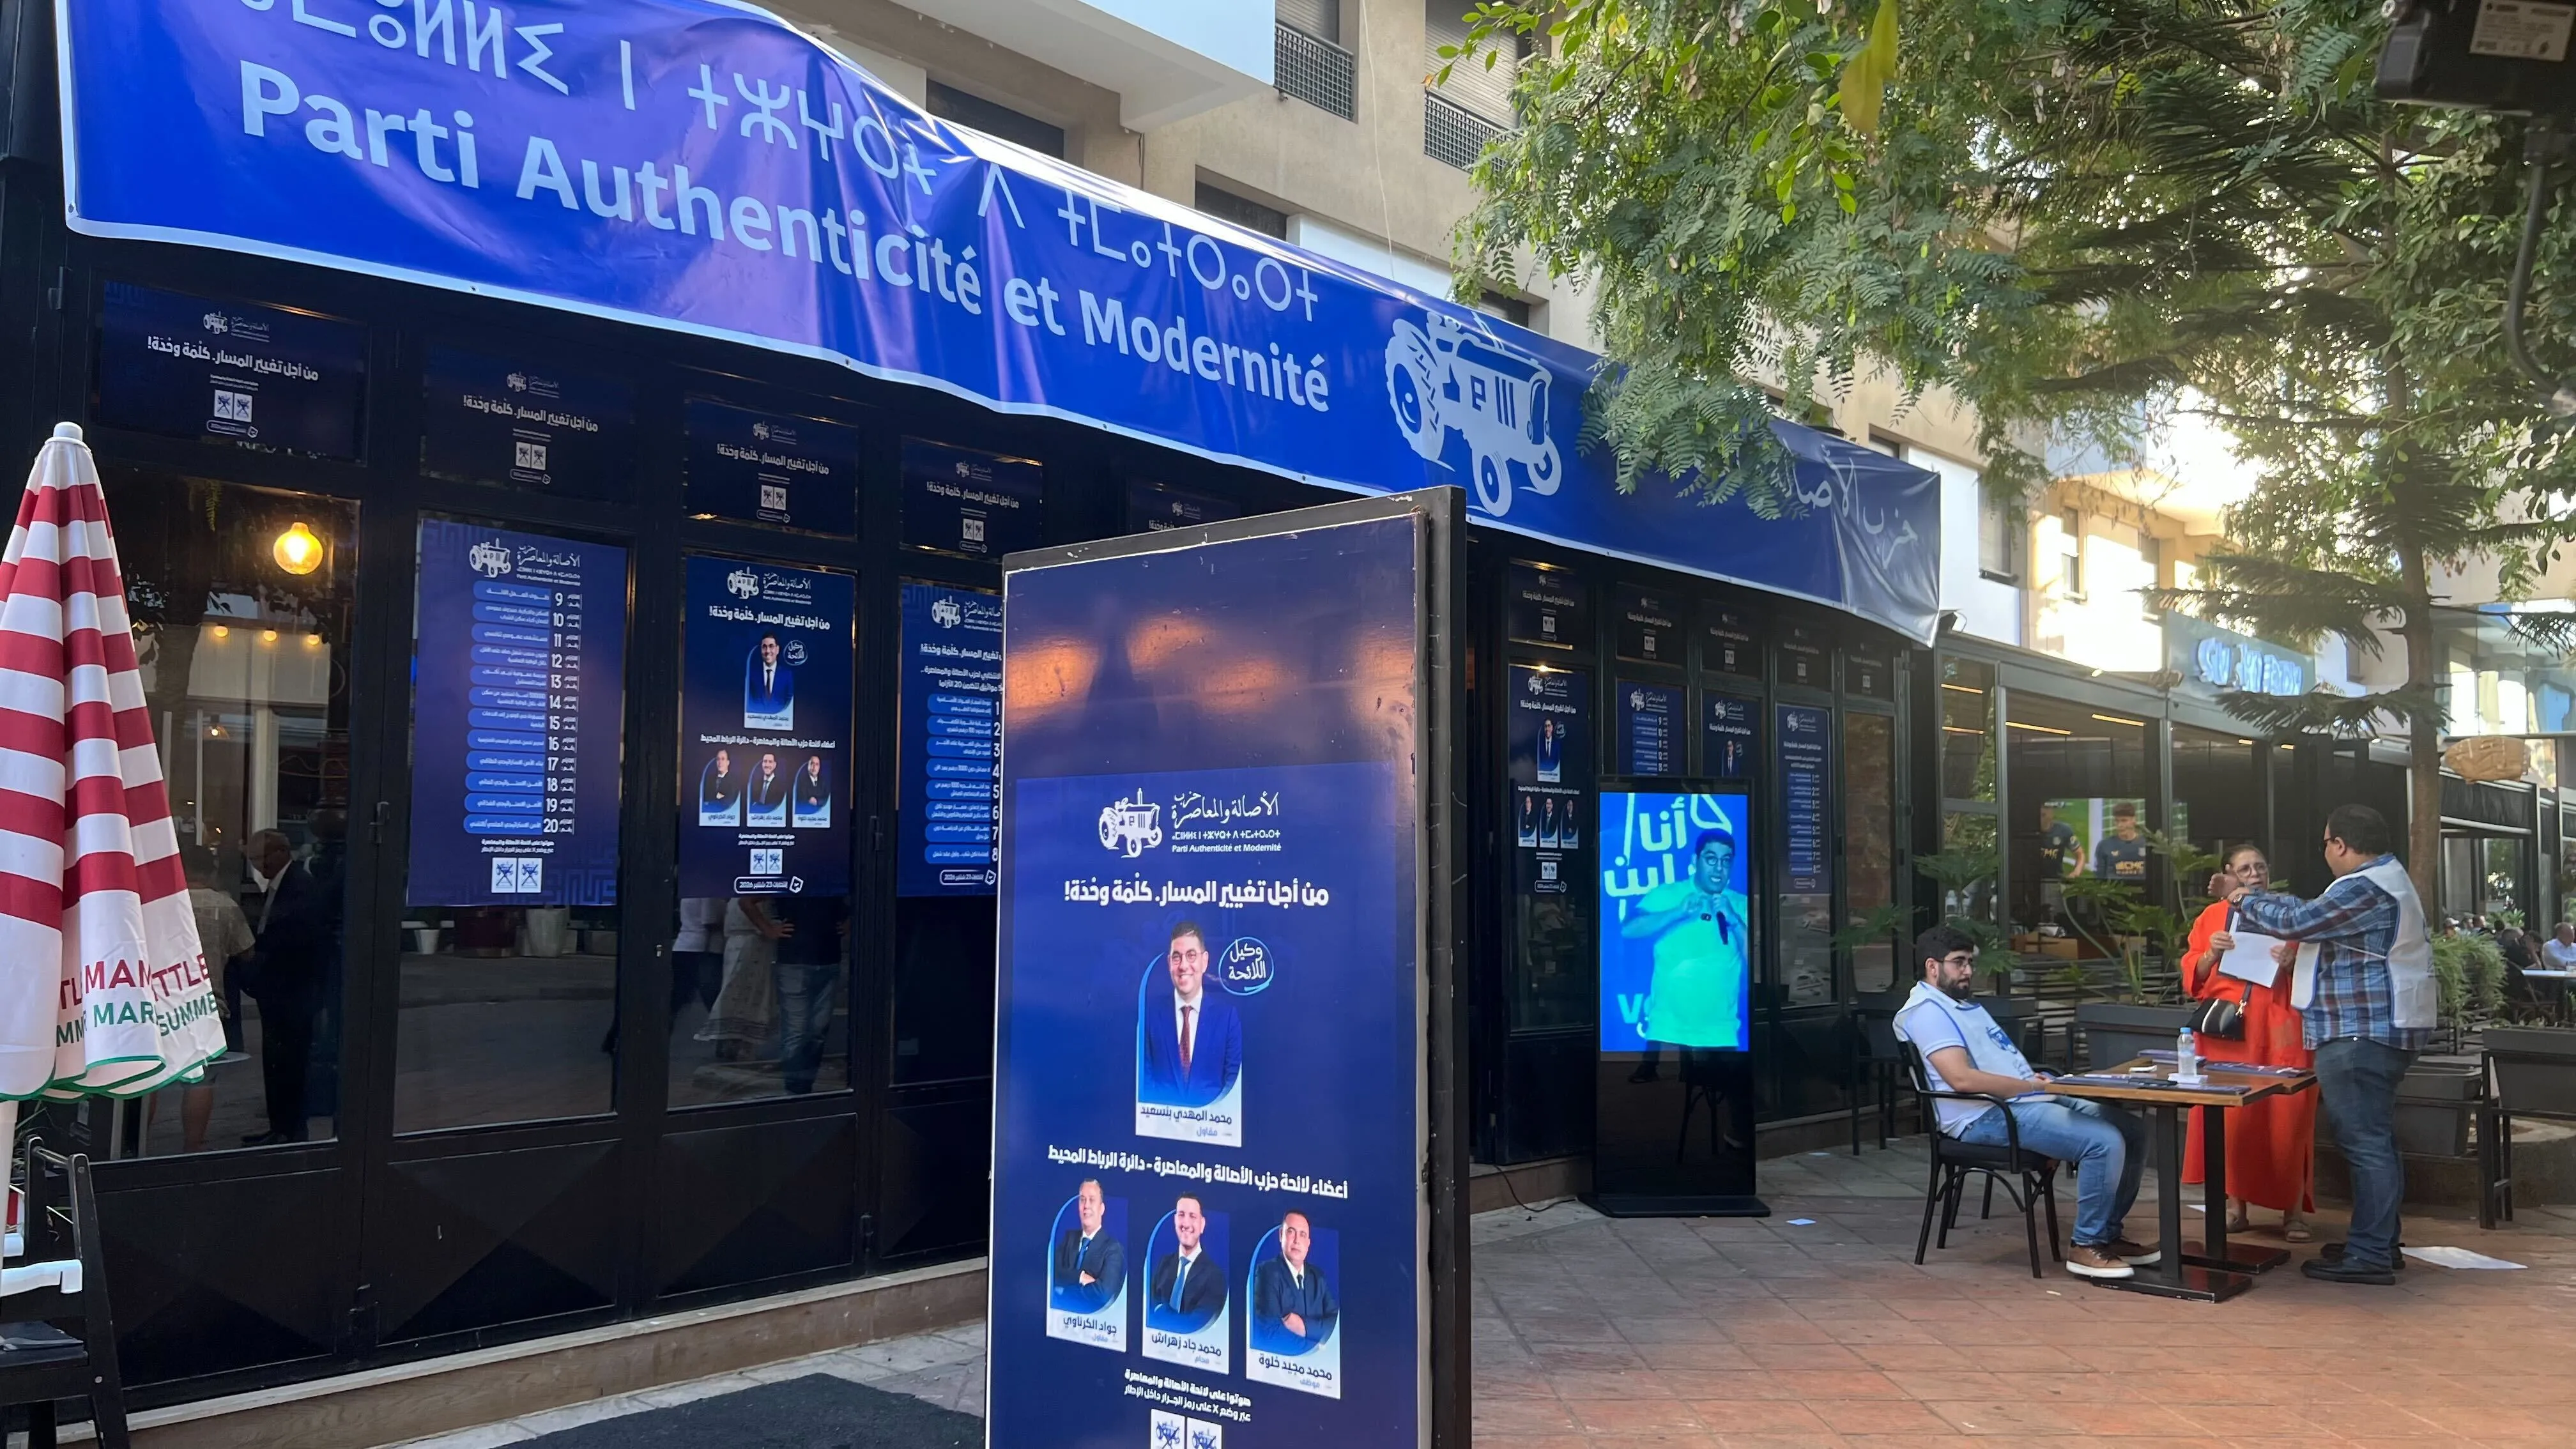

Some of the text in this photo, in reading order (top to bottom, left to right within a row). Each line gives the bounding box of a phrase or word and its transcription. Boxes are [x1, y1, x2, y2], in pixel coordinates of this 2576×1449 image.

[240, 59, 1330, 413] Parti Authenticité et Modernité
[1782, 438, 1860, 525] الأصا
[555, 592, 564, 606] 9
[553, 613, 564, 627] 10
[553, 633, 562, 647] 11
[551, 653, 563, 668] 12
[551, 674, 562, 689] 13
[549, 694, 562, 709] 14
[995, 701, 1000, 716] 1
[549, 716, 560, 730] 15
[993, 721, 1001, 737] 2
[548, 736, 560, 751] 16
[993, 742, 1000, 757] 3
[548, 756, 558, 771] 17
[992, 763, 1000, 778] 4
[547, 777, 558, 792] 18
[992, 784, 1000, 799] 5
[546, 797, 558, 813] 19
[1174, 791, 1202, 808] حزب
[992, 805, 999, 820] 6
[1171, 790, 1279, 829] الأصالة والمعاصرة
[543, 818, 558, 833] 20
[1639, 796, 1687, 852] أنا
[992, 826, 999, 841] 7
[992, 847, 999, 862] 8
[1172, 843, 1282, 853] Parti Authenticité et Modernité
[1154, 880, 1216, 907] المسار.
[1218, 878, 1266, 908] تغيير
[1268, 877, 1298, 909] أجل
[1302, 881, 1329, 907] من
[1230, 939, 1263, 963] وكيل
[1228, 960, 1266, 981] اللائحة
[1140, 1105, 1232, 1125] محمد المهدي بنسعيد
[1047, 1144, 1086, 1165] المحيط
[1087, 1149, 1117, 1170] الرباط
[1119, 1152, 1146, 1172] دائرة
[1154, 1156, 1213, 1183] والمعاصرة
[1213, 1163, 1253, 1186] الأصالة
[1254, 1171, 1278, 1192] حزب
[1280, 1172, 1310, 1193] لائحة
[1312, 1178, 1348, 1199] أعضاء
[1062, 1314, 1117, 1335] جواد الكرناوي
[1182, 1339, 1197, 1354] جاد
[1198, 1344, 1222, 1357] محمد
[1280, 1360, 1305, 1376] مجيد
[1306, 1365, 1333, 1381] محمد
[1124, 1368, 1252, 1407] صوتوا على لائحة الأصالة والمعاصرة
[1195, 1401, 1212, 1413] على
[1213, 1404, 1219, 1414] X
